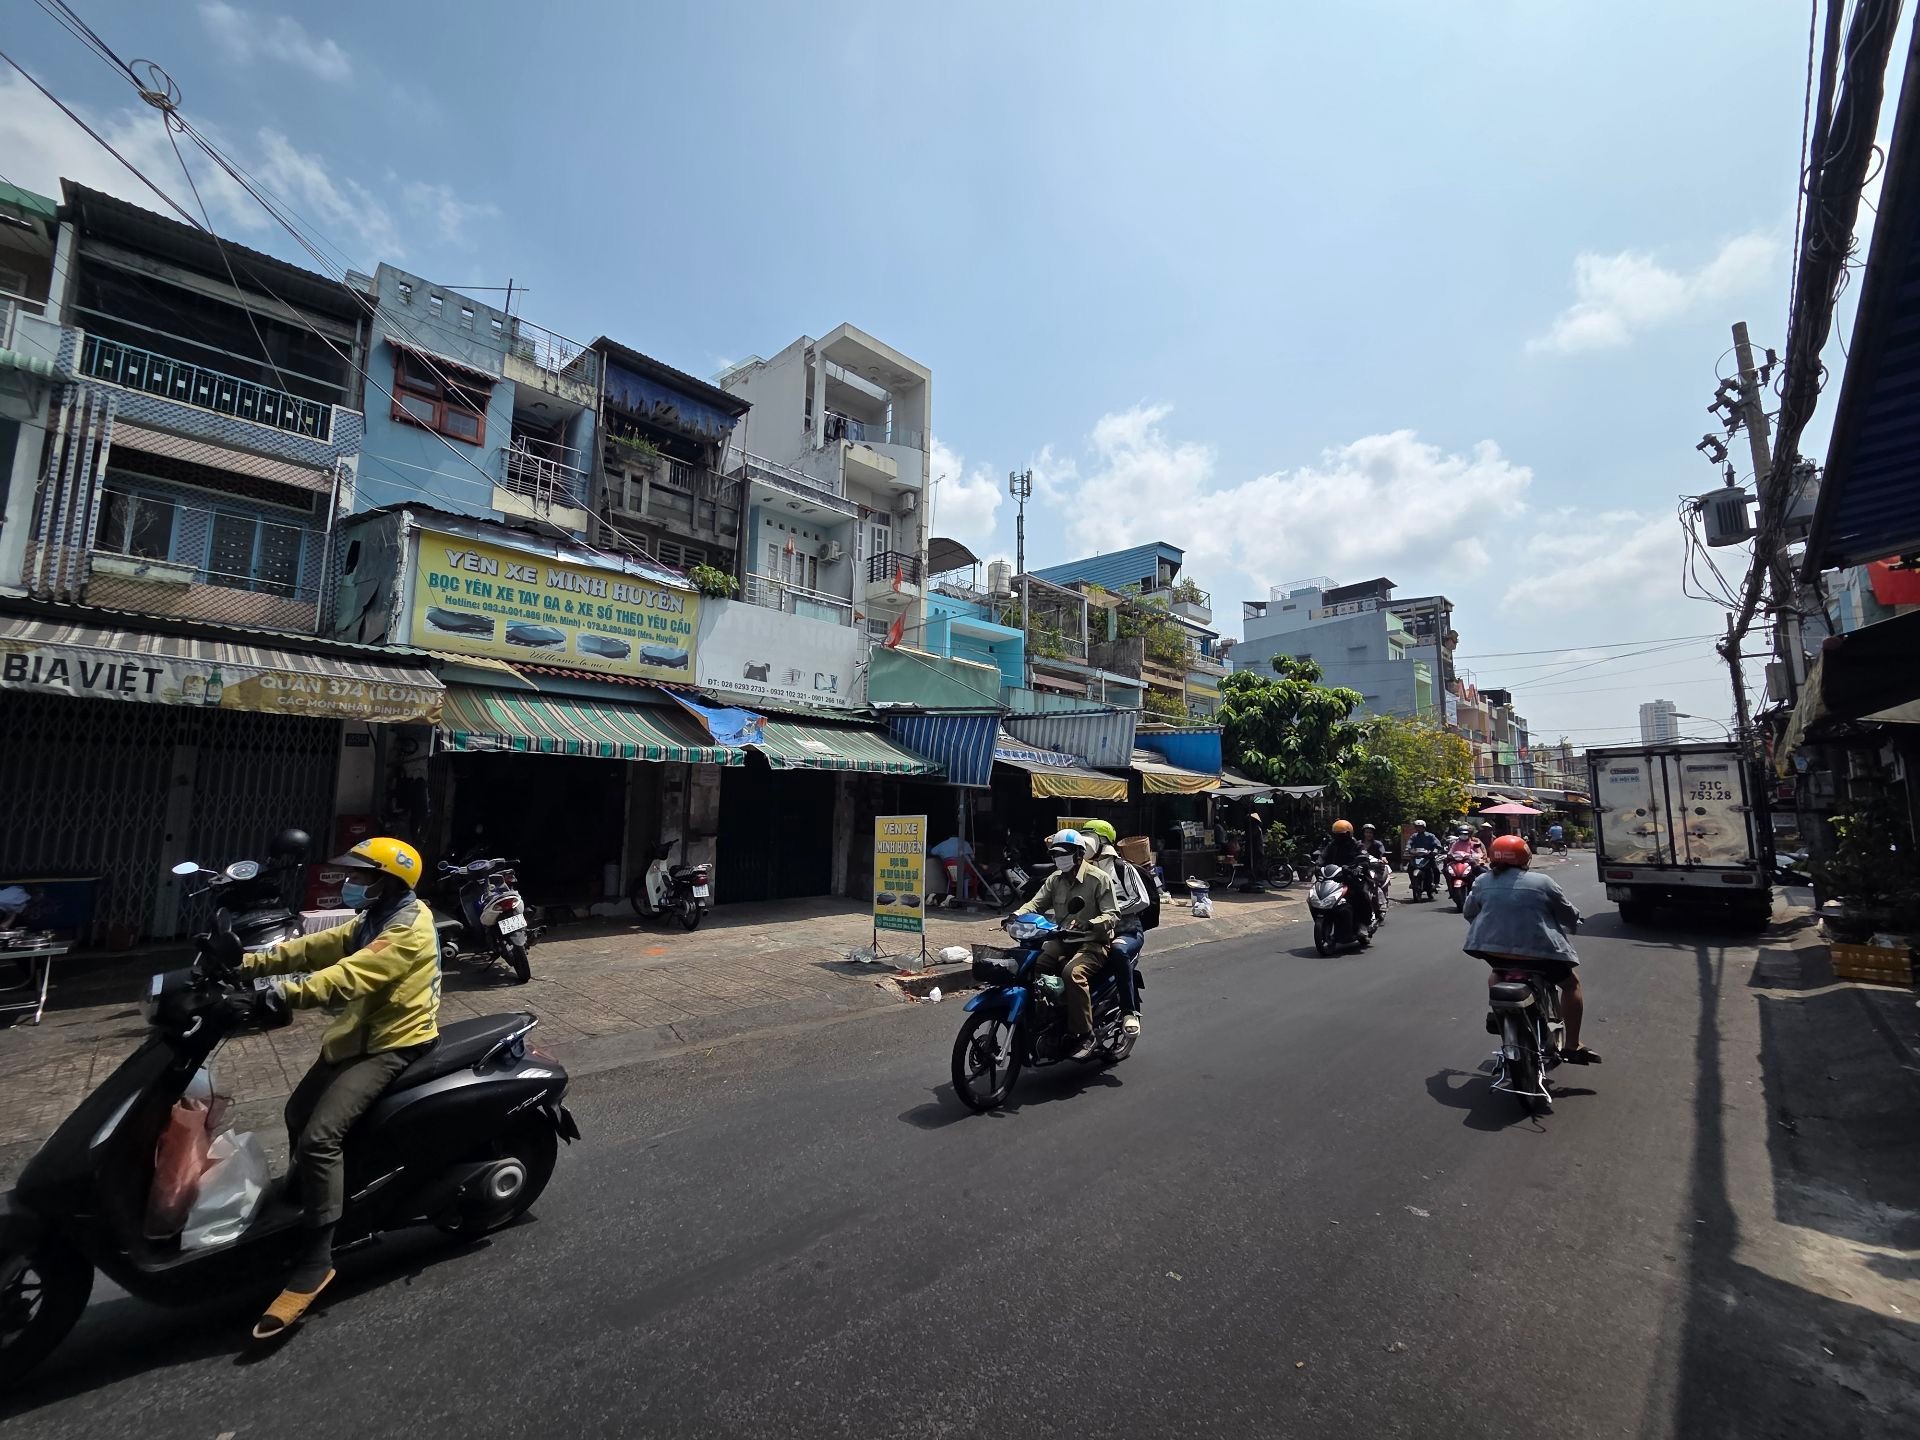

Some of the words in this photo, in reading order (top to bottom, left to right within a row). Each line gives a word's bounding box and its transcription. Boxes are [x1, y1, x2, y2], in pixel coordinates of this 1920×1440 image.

[445, 548, 498, 576] YÊN
[505, 561, 537, 585] XE
[546, 567, 608, 598] MINH
[429, 572, 460, 592] BỌC
[465, 578, 492, 598] YÊN
[496, 585, 514, 602] XE
[518, 589, 540, 607] TAY
[543, 595, 560, 611] GA
[564, 597, 575, 611] &
[577, 601, 594, 618] XE
[597, 603, 614, 620] SỐ
[616, 609, 643, 626] THEO
[445, 595, 480, 610] Hotline:
[2, 652, 71, 687] BIA
[78, 659, 164, 697] VIỆT
[328, 680, 364, 698] 374
[707, 678, 720, 687] ĐT:
[1699, 780, 1722, 791] 51C
[1689, 790, 1732, 801] 753.28
[905, 823, 919, 836] XE
[876, 841, 897, 854] MINH
[396, 851, 414, 869] be
